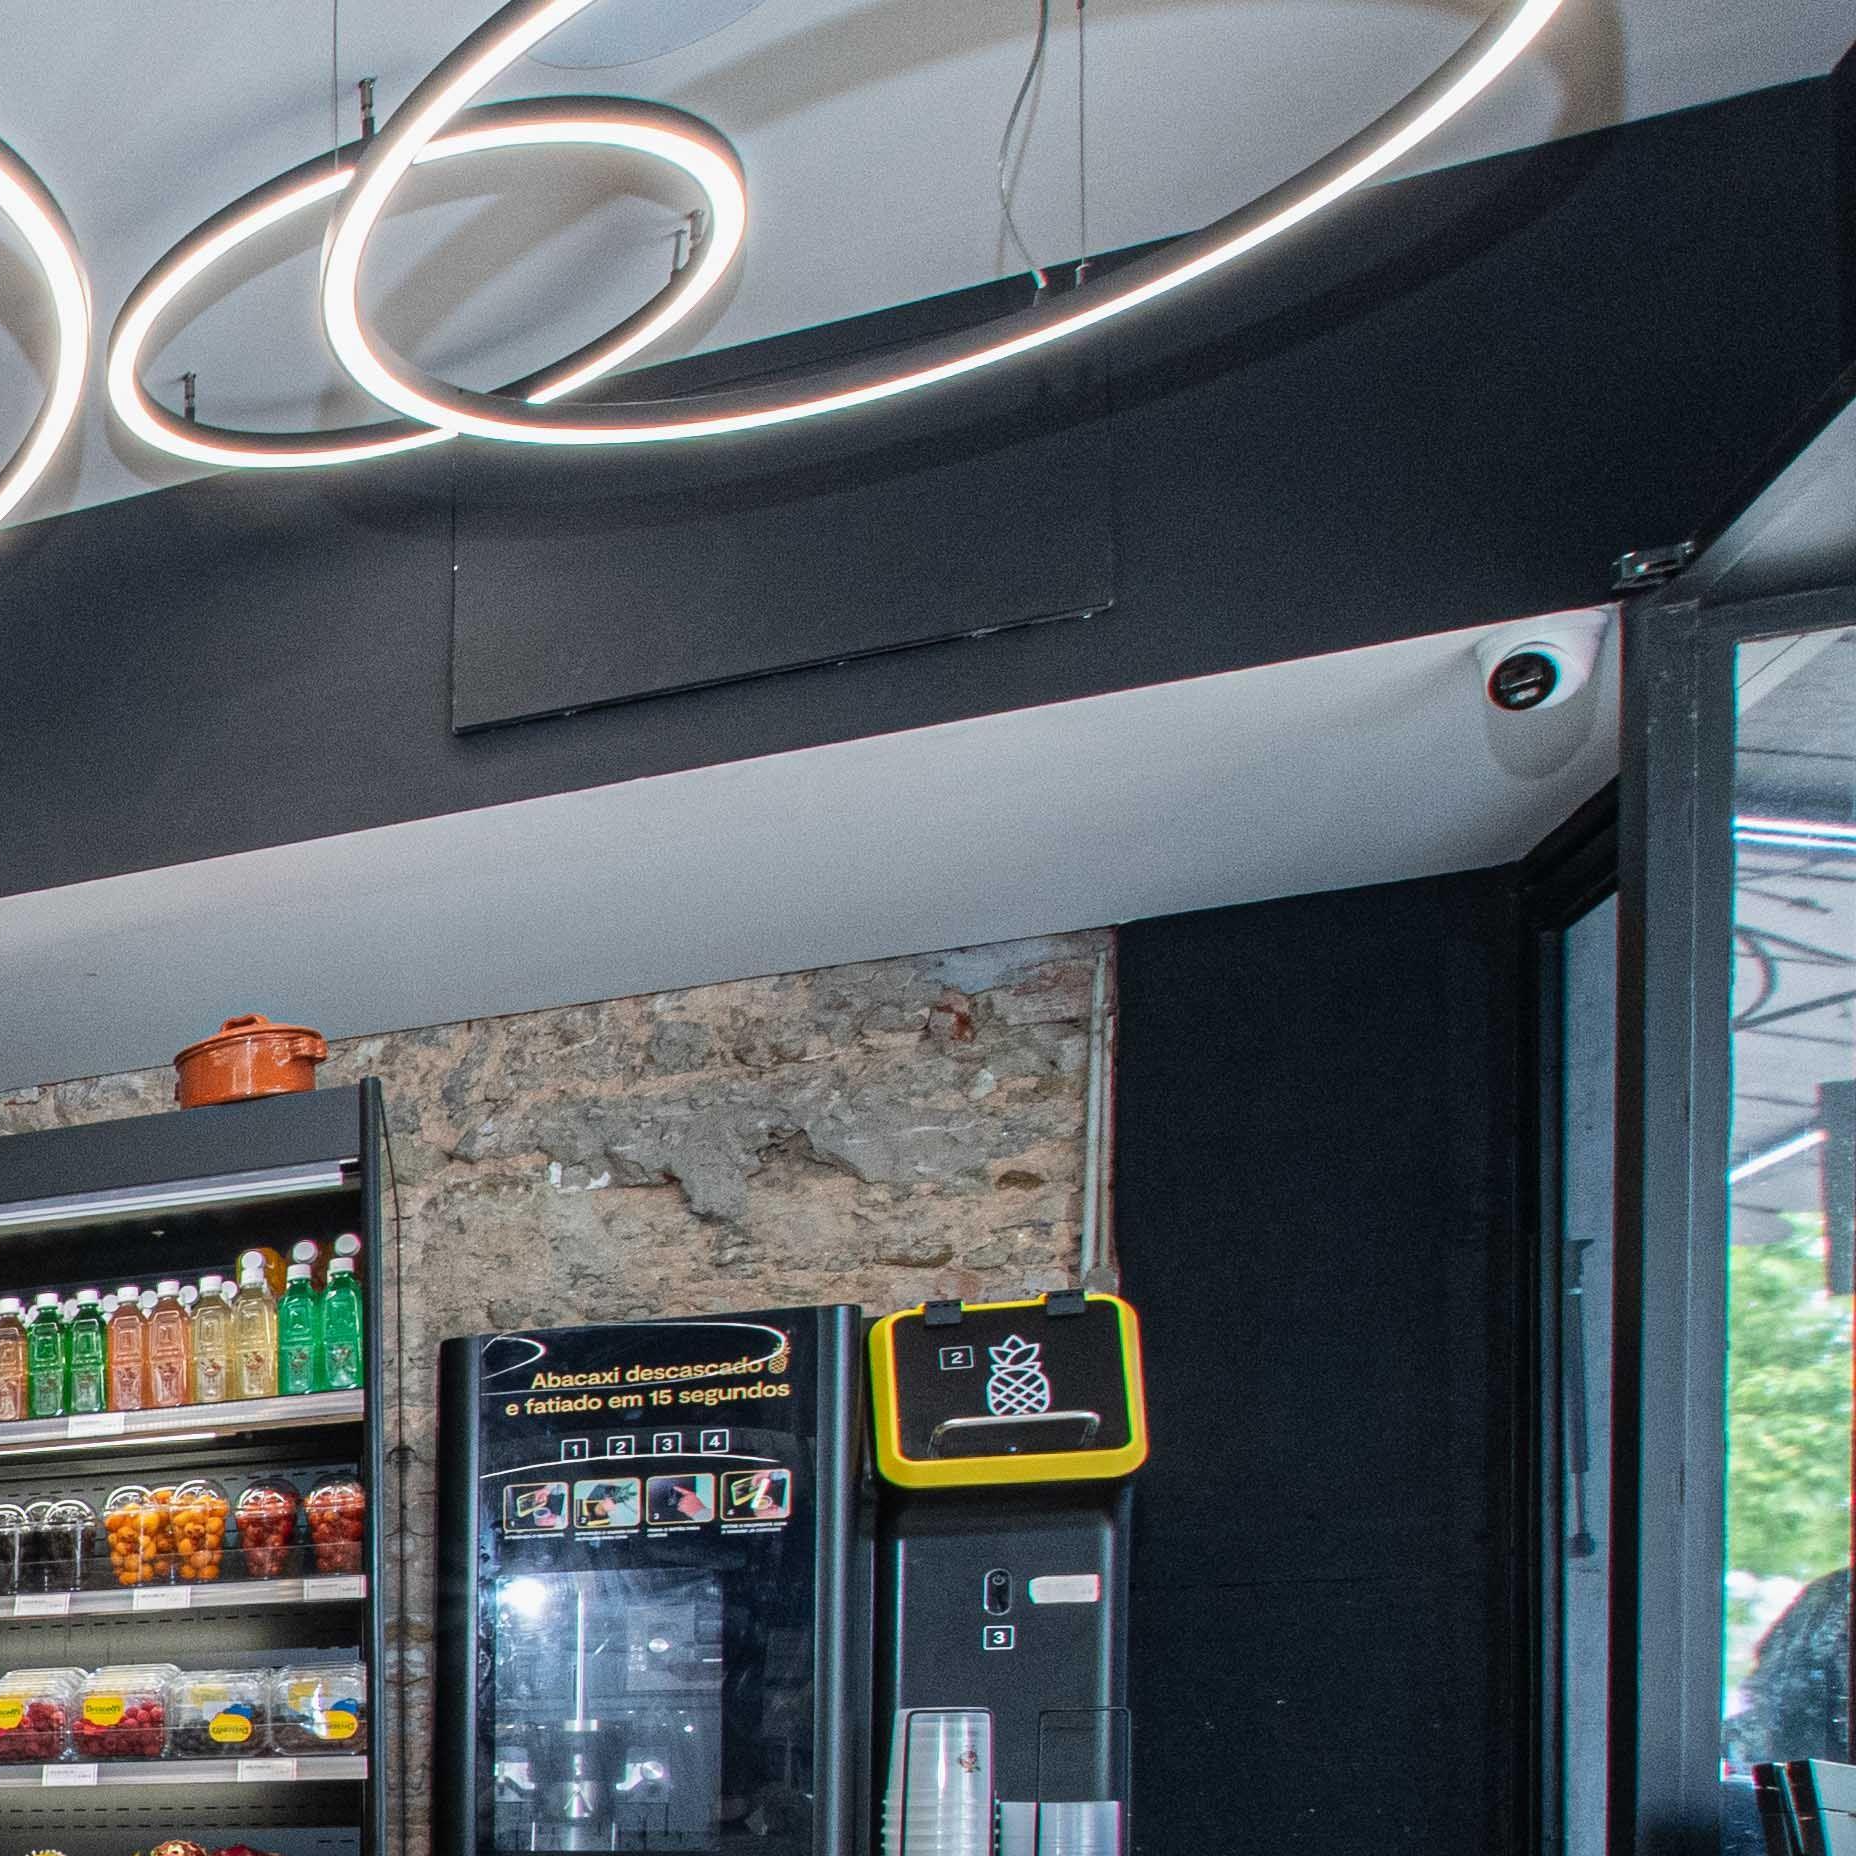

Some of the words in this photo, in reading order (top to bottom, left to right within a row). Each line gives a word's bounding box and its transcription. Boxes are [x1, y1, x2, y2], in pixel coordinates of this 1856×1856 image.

[531, 1365, 623, 1392] Abacaxi
[625, 1356, 764, 1383] descascado
[506, 1401, 519, 1416] e
[524, 1391, 603, 1416] fatiado
[607, 1394, 645, 1410] em
[648, 1386, 673, 1406] 15
[676, 1377, 791, 1409] segundos
